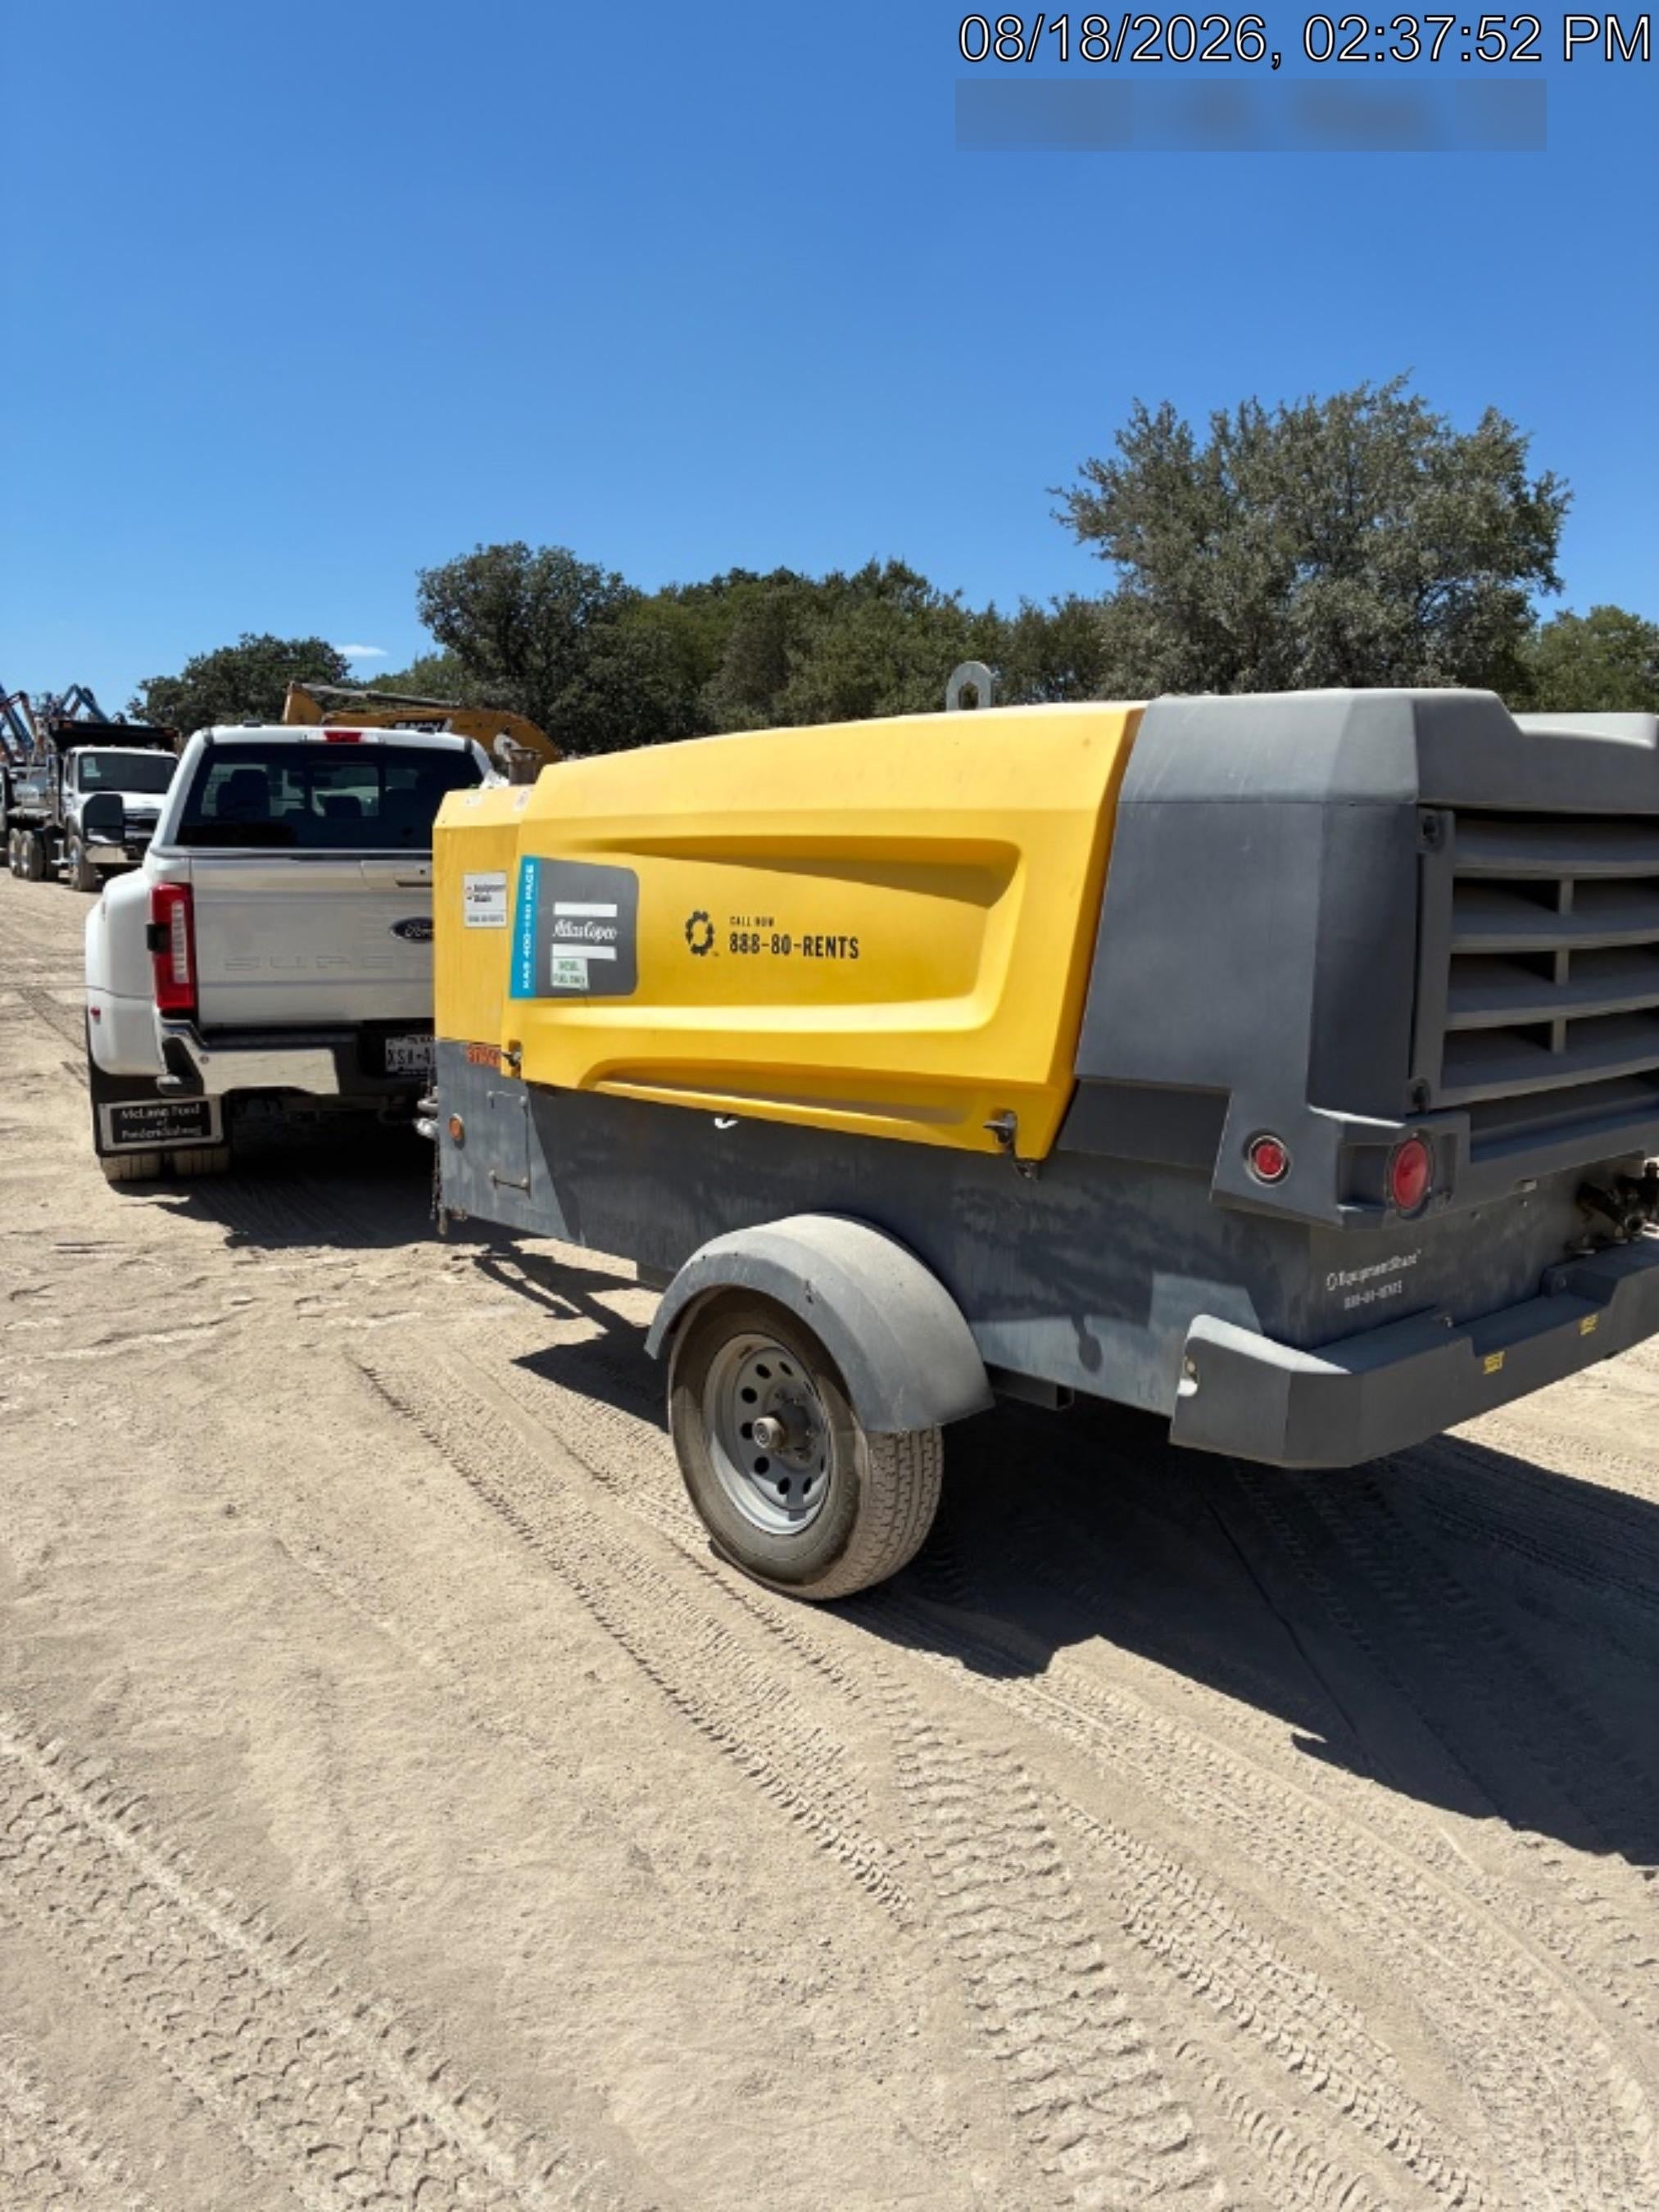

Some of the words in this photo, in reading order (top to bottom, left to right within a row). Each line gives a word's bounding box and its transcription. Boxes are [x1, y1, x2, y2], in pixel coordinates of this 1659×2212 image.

[730, 916, 751, 927] CALL
[755, 917, 774, 927] NOW
[730, 932, 859, 959] 888-80-RENTS
